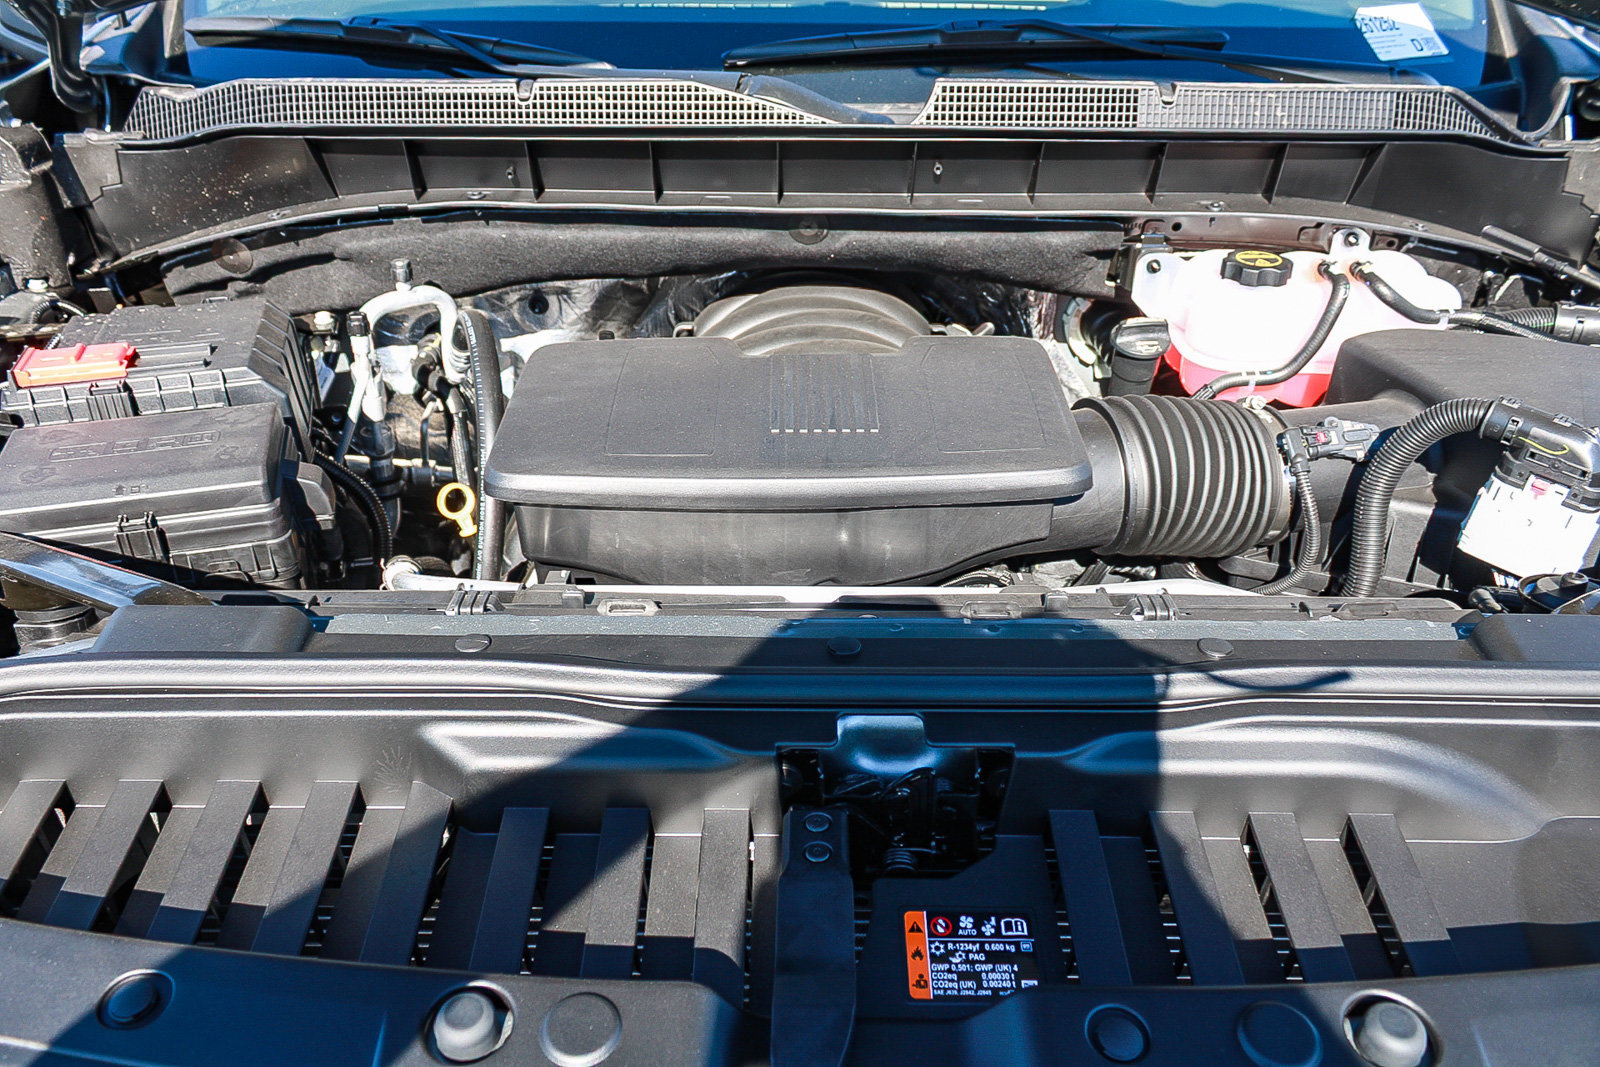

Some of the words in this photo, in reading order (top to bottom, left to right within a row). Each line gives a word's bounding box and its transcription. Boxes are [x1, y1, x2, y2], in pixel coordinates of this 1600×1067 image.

[1410, 38, 1424, 51] D
[948, 942, 980, 952] R-1234yf
[1006, 944, 1016, 952] kg
[951, 964, 974, 972] 0.501;
[995, 964, 1012, 972] (UK)
[932, 972, 958, 980] CO2eq
[932, 980, 958, 989] CO2eq
[960, 981, 976, 990] (UK)
